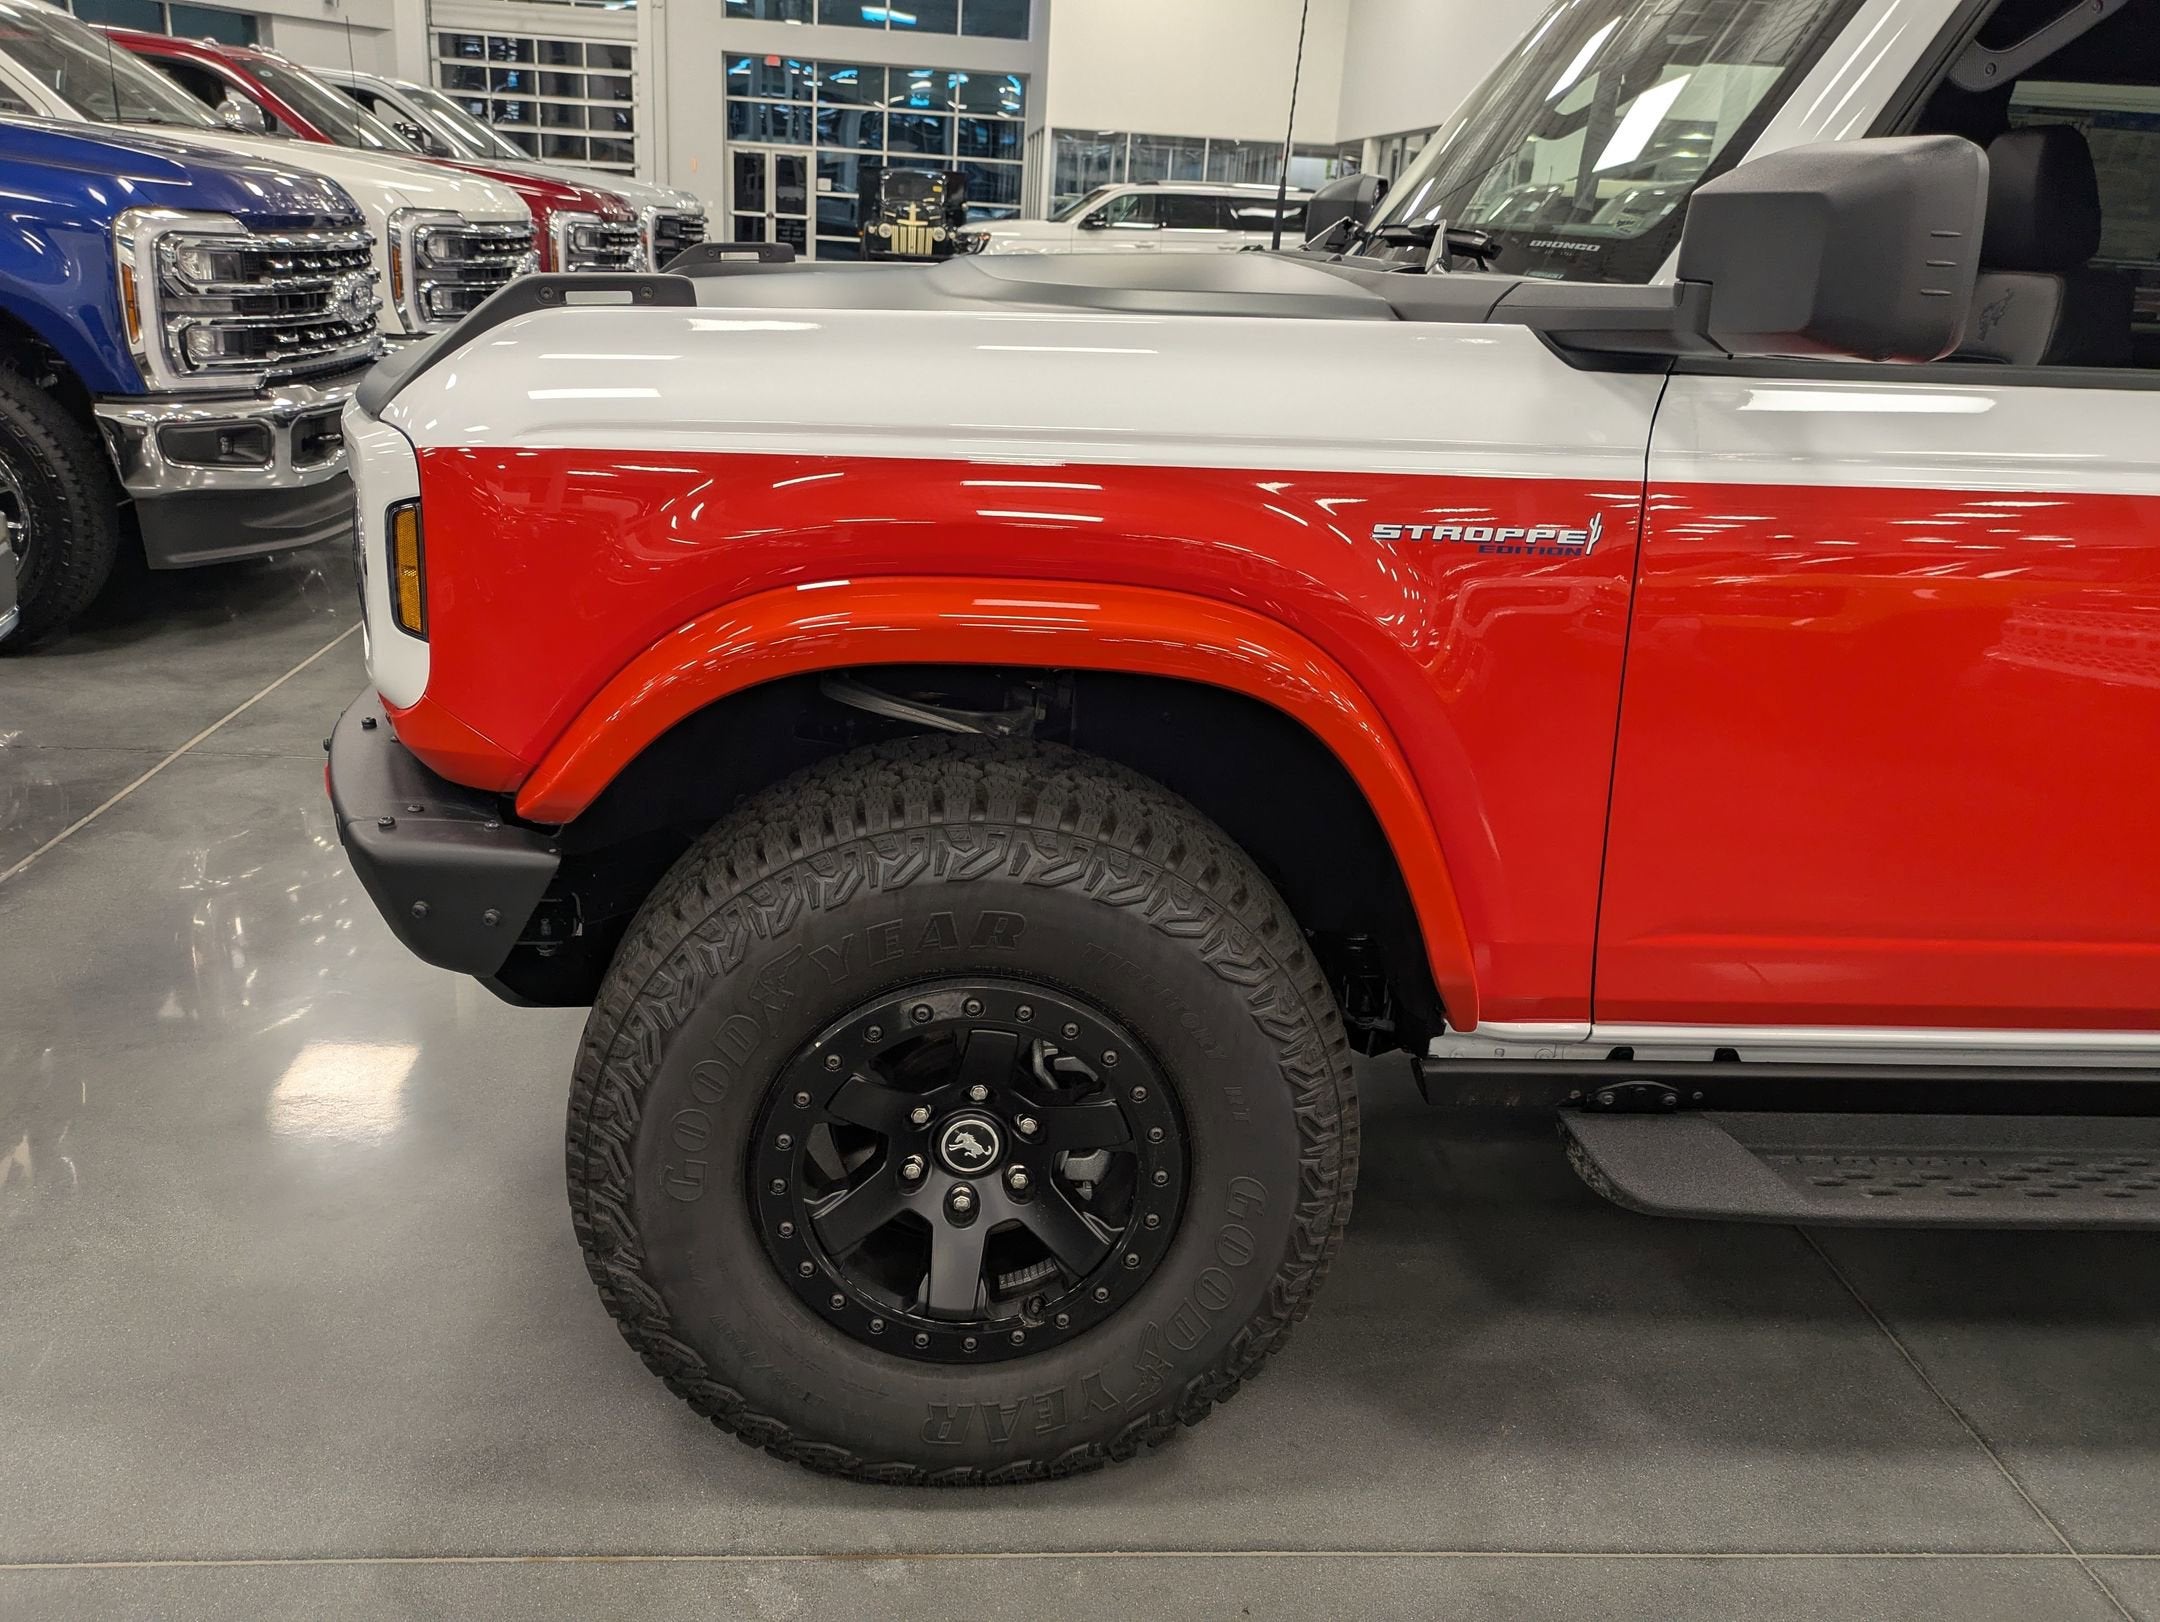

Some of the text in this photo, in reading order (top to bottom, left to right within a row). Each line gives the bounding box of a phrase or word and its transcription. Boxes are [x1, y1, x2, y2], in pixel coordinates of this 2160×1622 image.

[1529, 239, 1601, 252] BRONCO
[1372, 523, 1588, 545] STROPPE
[1477, 544, 1582, 556] EDITION
